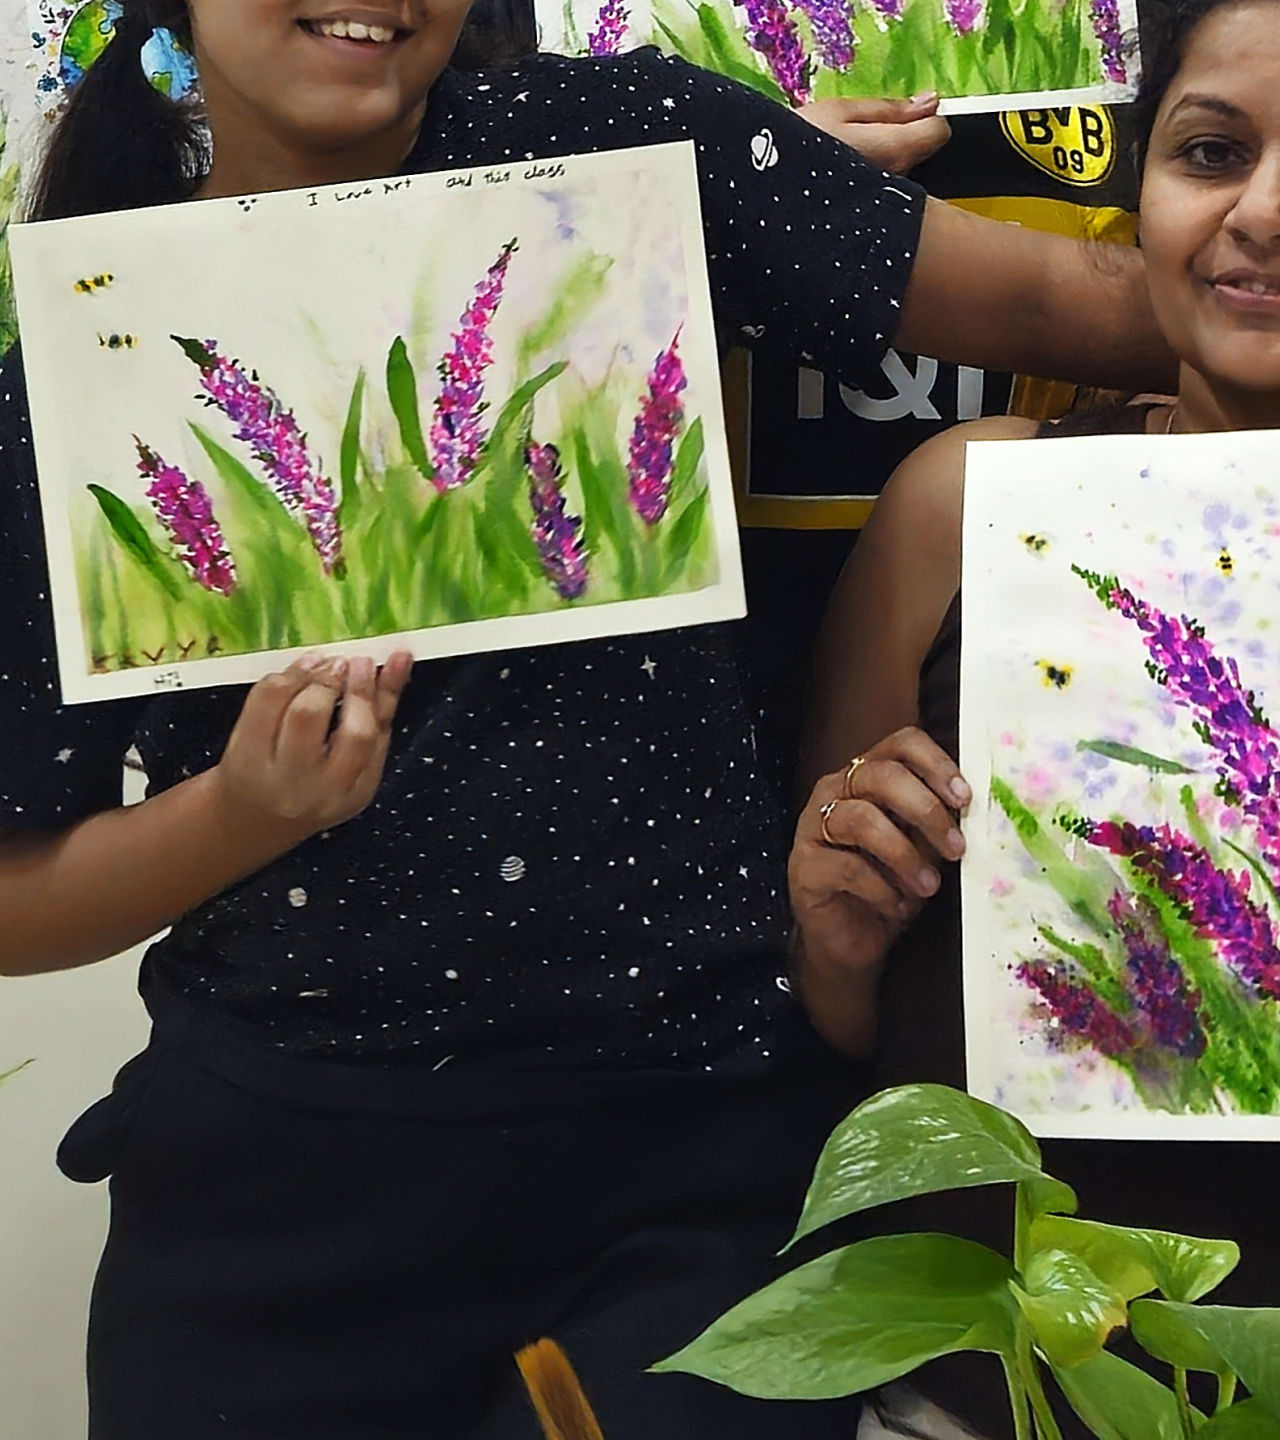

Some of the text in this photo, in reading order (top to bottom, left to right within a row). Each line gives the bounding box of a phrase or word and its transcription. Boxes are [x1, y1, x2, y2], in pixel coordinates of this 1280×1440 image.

[1052, 145, 1085, 174] 09
[307, 192, 318, 206] I
[383, 178, 411, 194] Art
